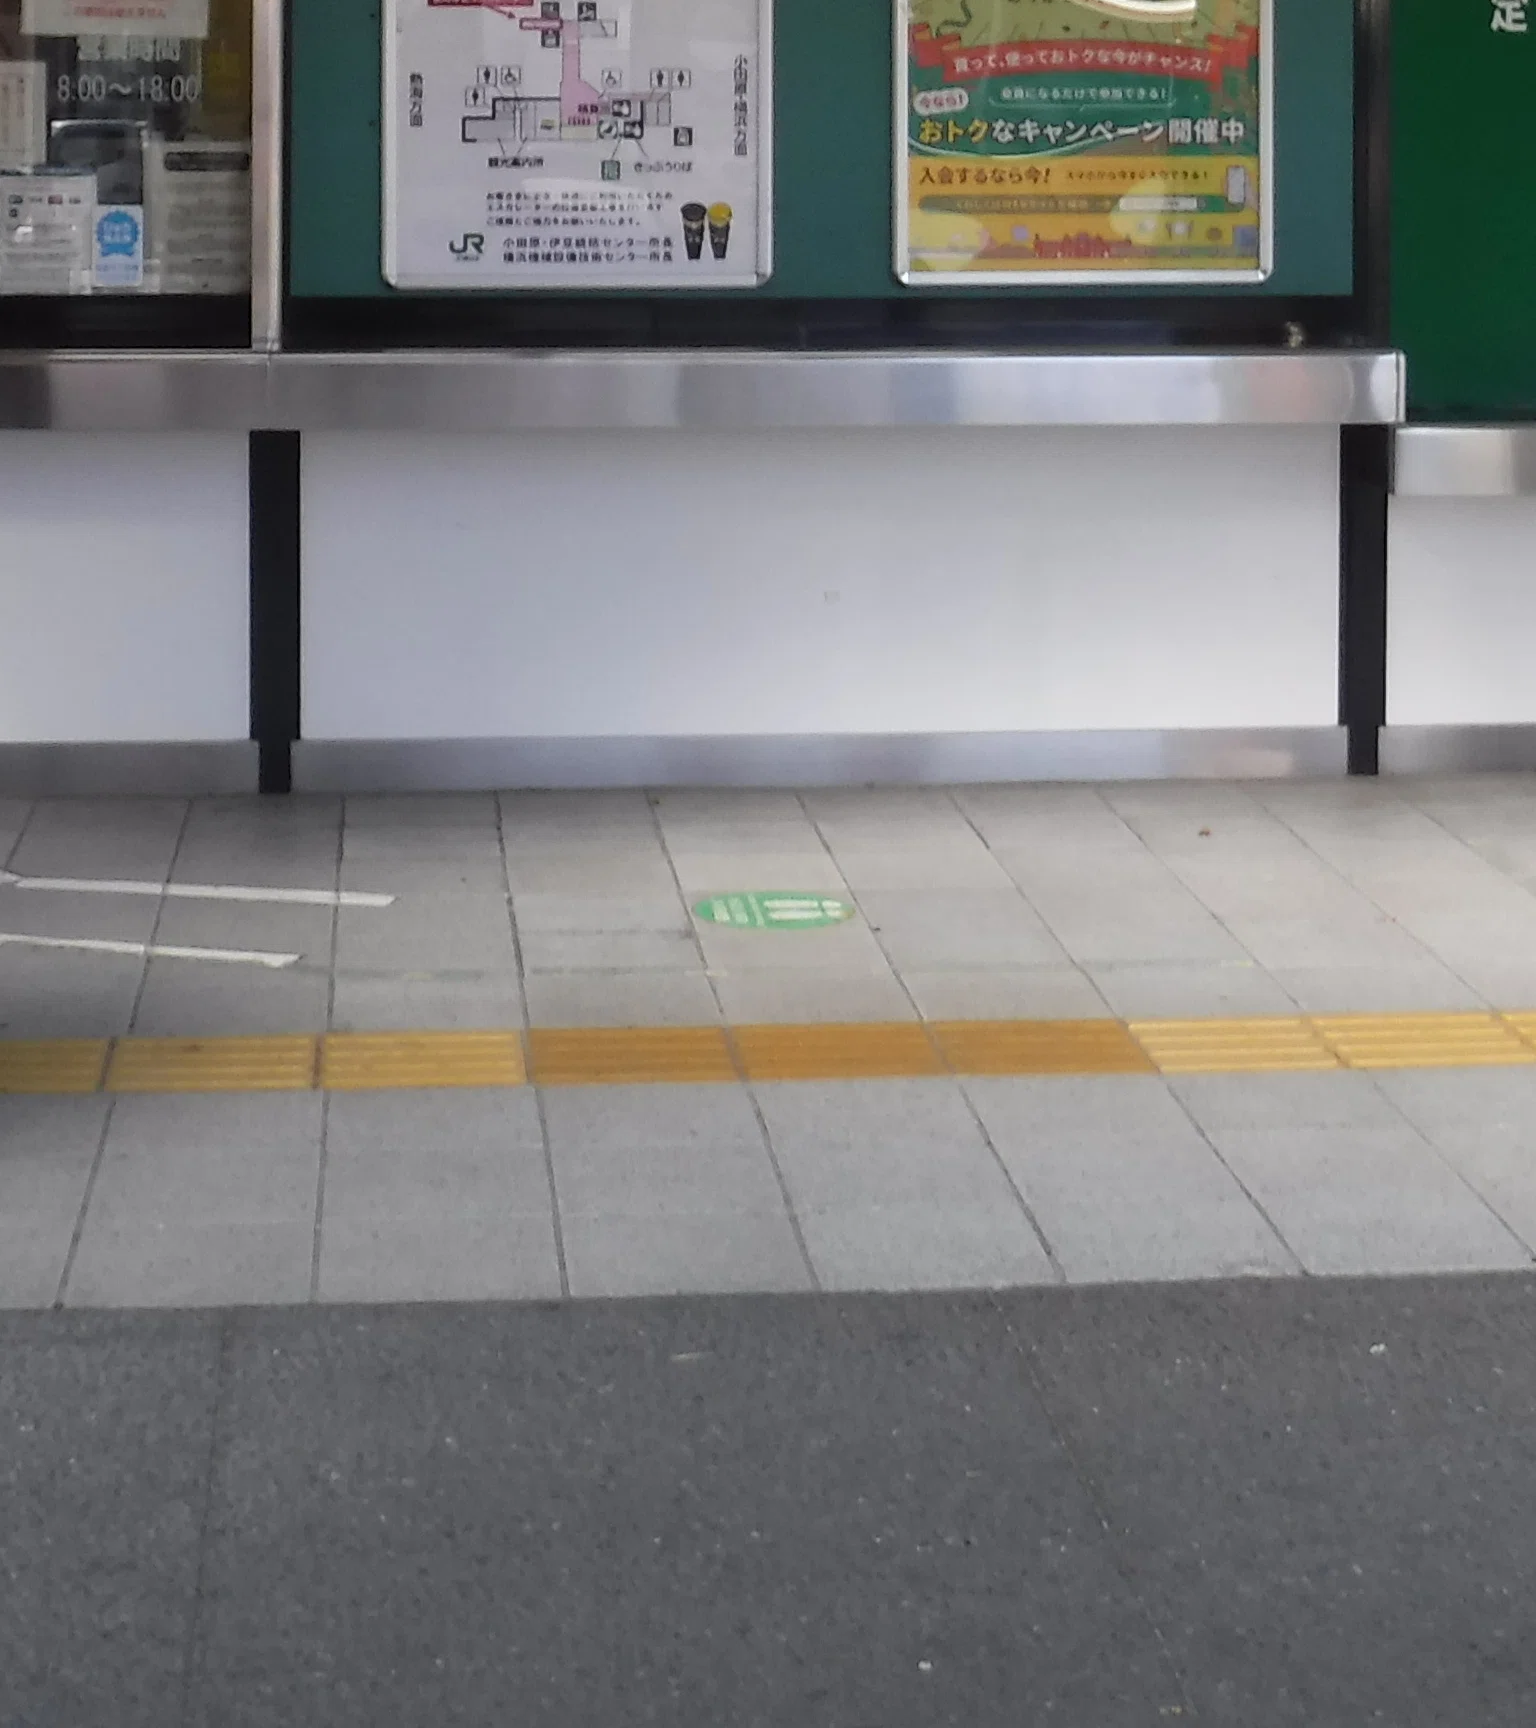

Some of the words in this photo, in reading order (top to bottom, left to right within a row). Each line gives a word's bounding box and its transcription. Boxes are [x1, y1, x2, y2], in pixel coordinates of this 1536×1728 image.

[919, 118, 1245, 145] おトクなキャンペーン開催中
[449, 233, 484, 254] JR
